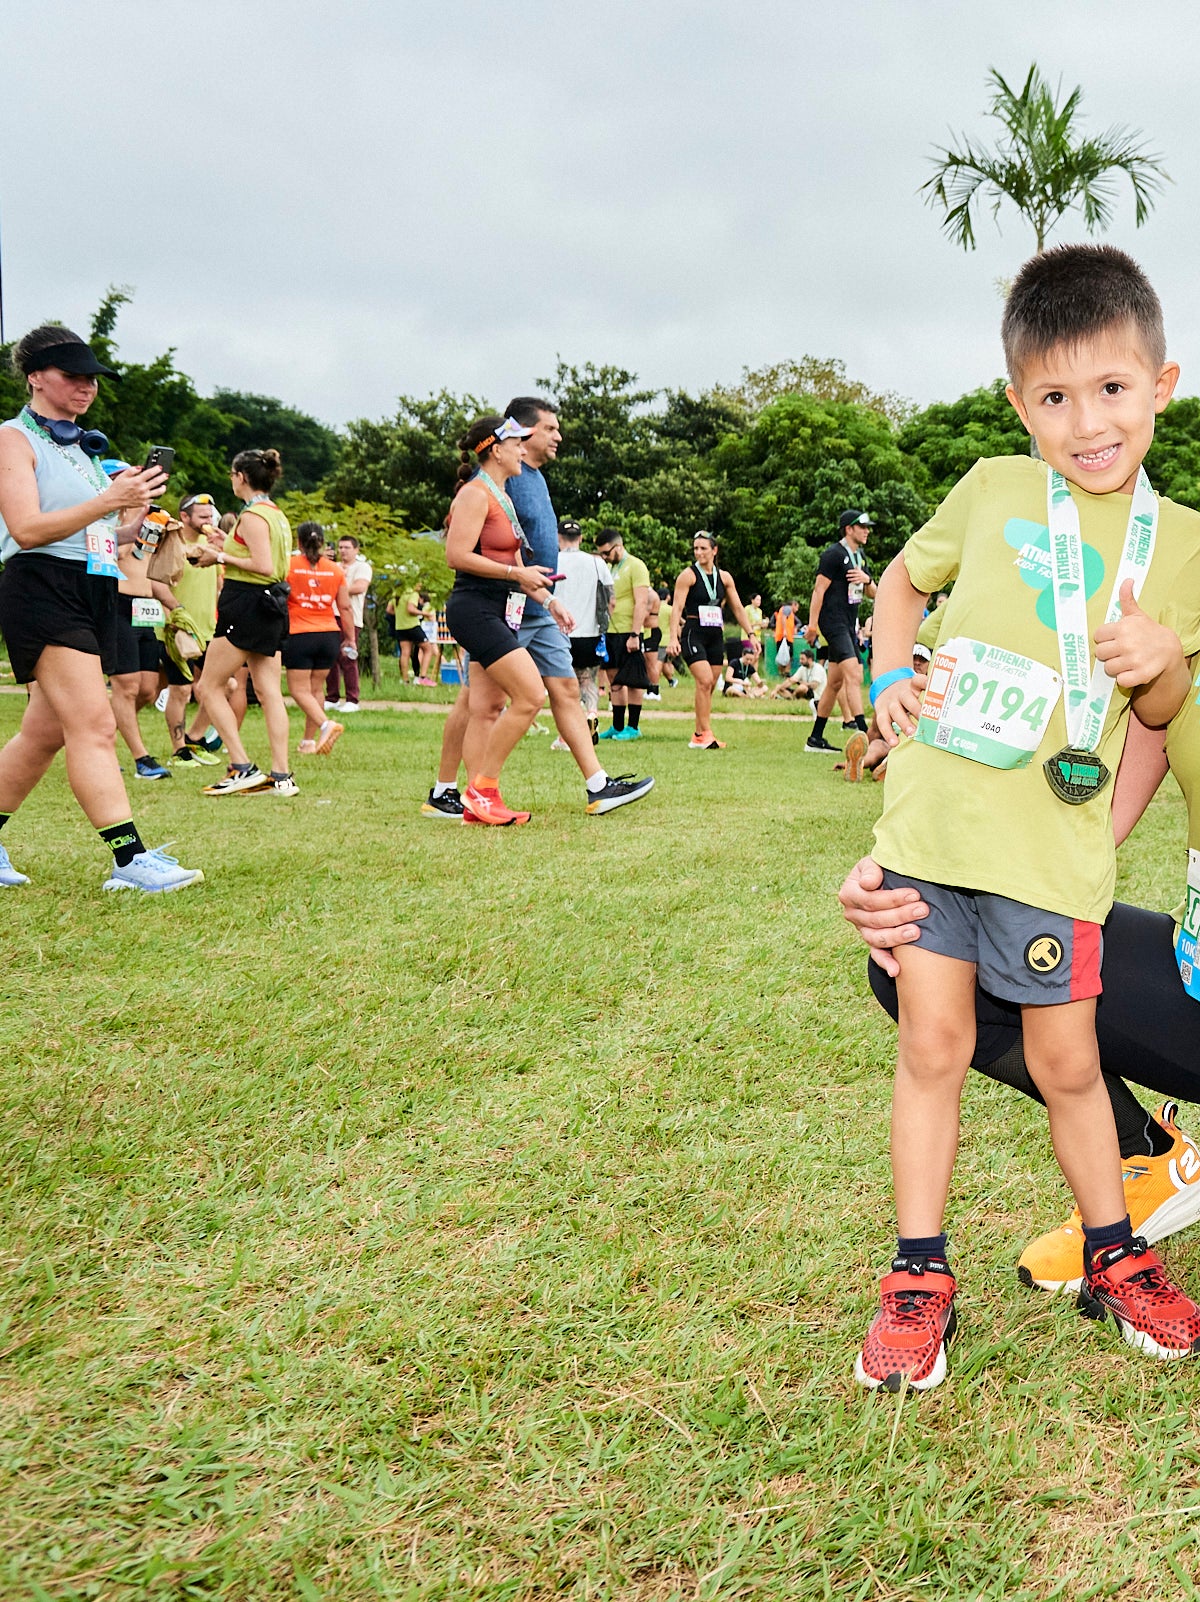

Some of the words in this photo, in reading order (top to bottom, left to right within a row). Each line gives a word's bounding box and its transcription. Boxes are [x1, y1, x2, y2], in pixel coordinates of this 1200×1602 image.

[1018, 543, 1051, 567] ATHE
[1055, 533, 1071, 580] ATHENAS
[1069, 534, 1079, 560] FASTER
[1135, 526, 1152, 567] ATHENAS
[1013, 557, 1038, 571] KIDS
[1036, 566, 1053, 579] FAS
[140, 607, 160, 616] 7033
[986, 648, 1034, 671] ATHENAS
[1063, 633, 1081, 687] ATHENAS
[1077, 634, 1087, 666] FASTER
[935, 656, 956, 669] 100m
[1080, 668, 1088, 687] KIDS
[922, 704, 941, 719] 2020
[955, 672, 1049, 732] 9194
[980, 721, 1001, 734] JOAO
[1071, 763, 1100, 779] ATHENAS
[1181, 938, 1197, 959] 10K
